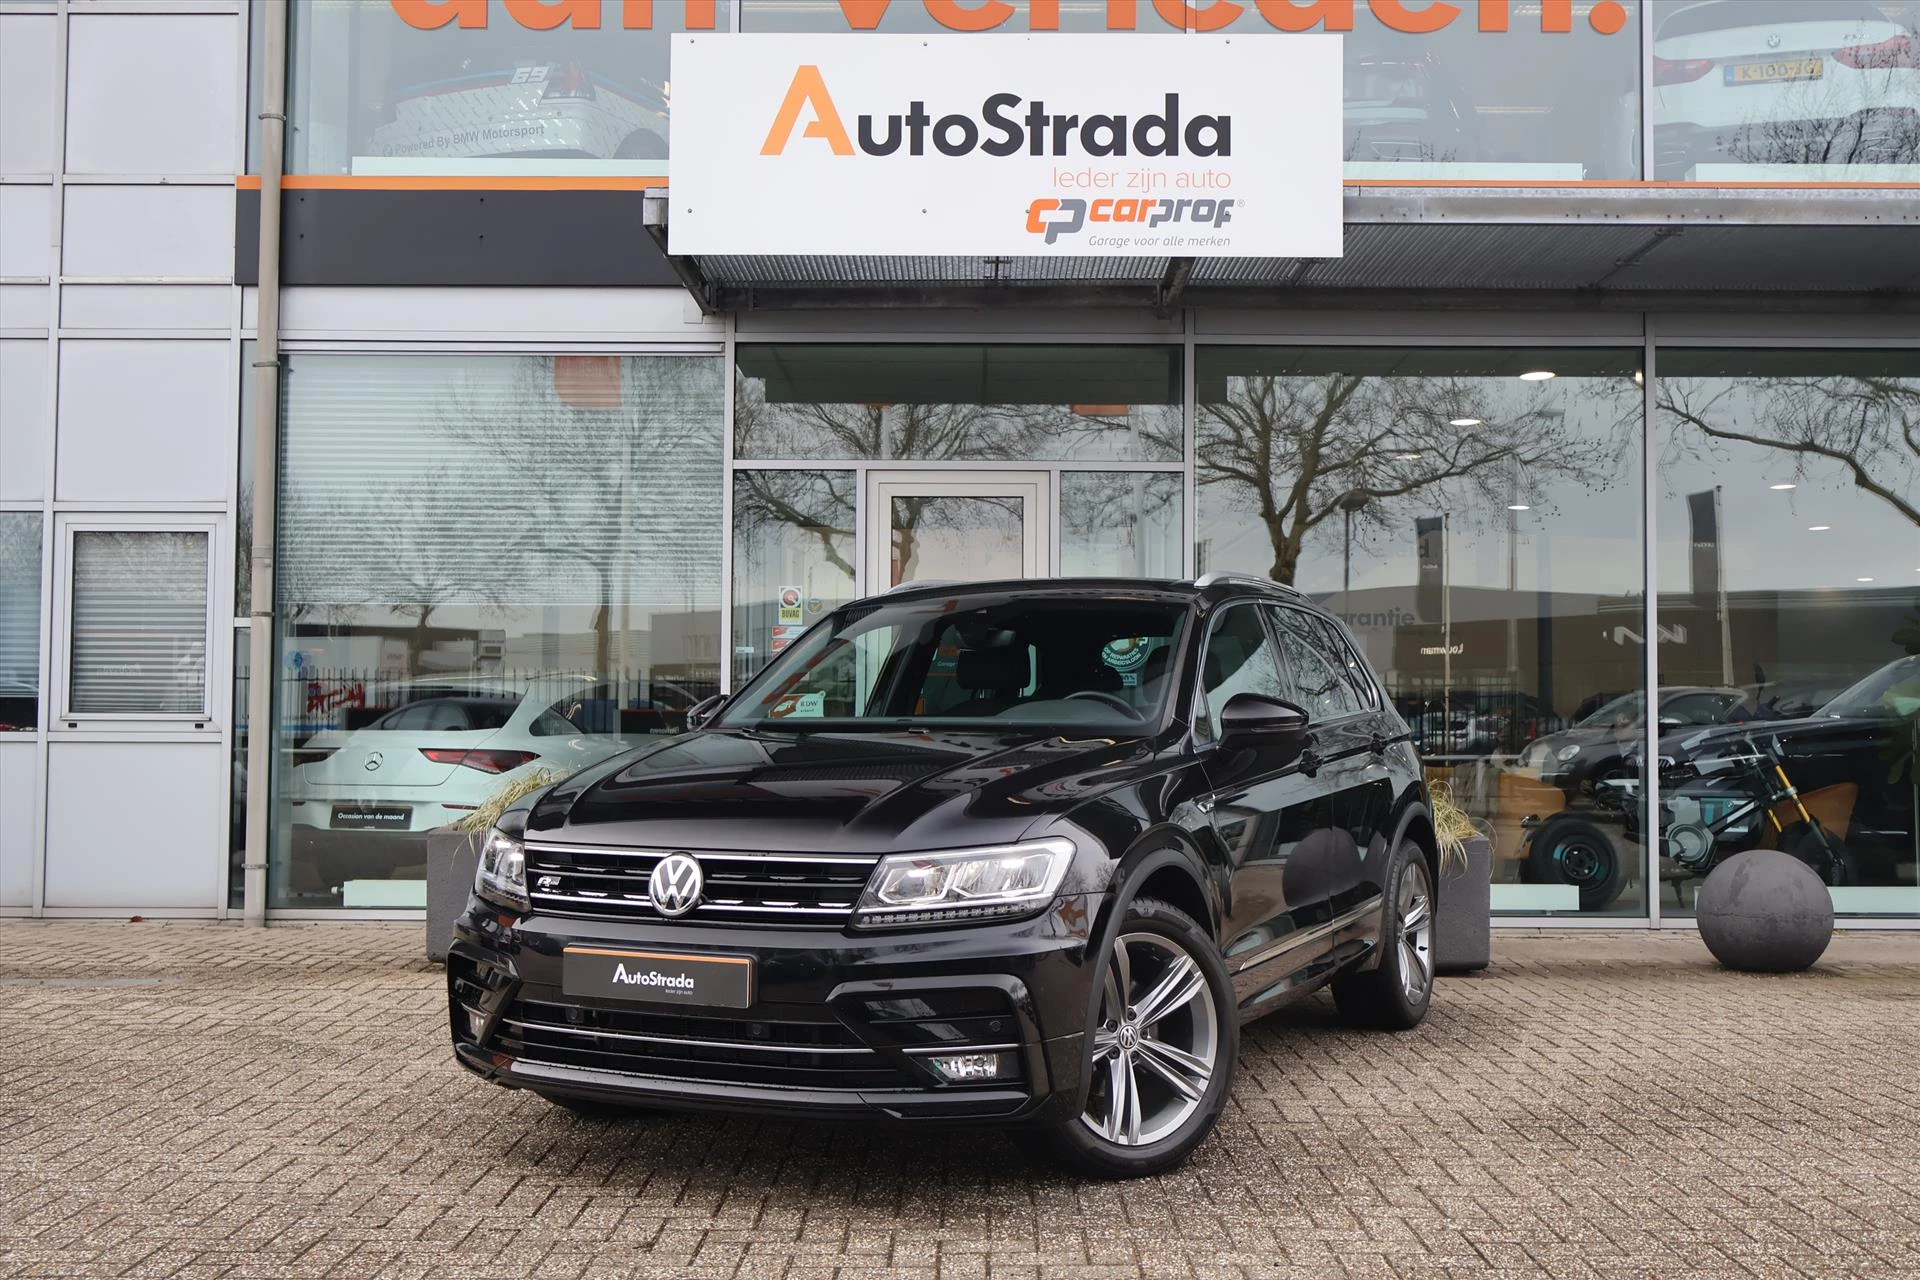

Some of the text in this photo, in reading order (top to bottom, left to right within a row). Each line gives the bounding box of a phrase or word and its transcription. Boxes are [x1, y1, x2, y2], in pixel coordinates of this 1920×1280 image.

[511, 66, 549, 83] 69
[759, 64, 1232, 157] AutoStrada
[395, 125, 545, 155] Powered By BMW Motorsport
[1053, 167, 1231, 193] Ieder zijn auto
[1089, 199, 1235, 228] carprof
[1089, 235, 1231, 248] Garage voor alle merken
[1326, 607, 1415, 627] arantie
[337, 812, 363, 820] Occasion
[383, 813, 405, 821] maand
[612, 963, 695, 989] AutoStrada
